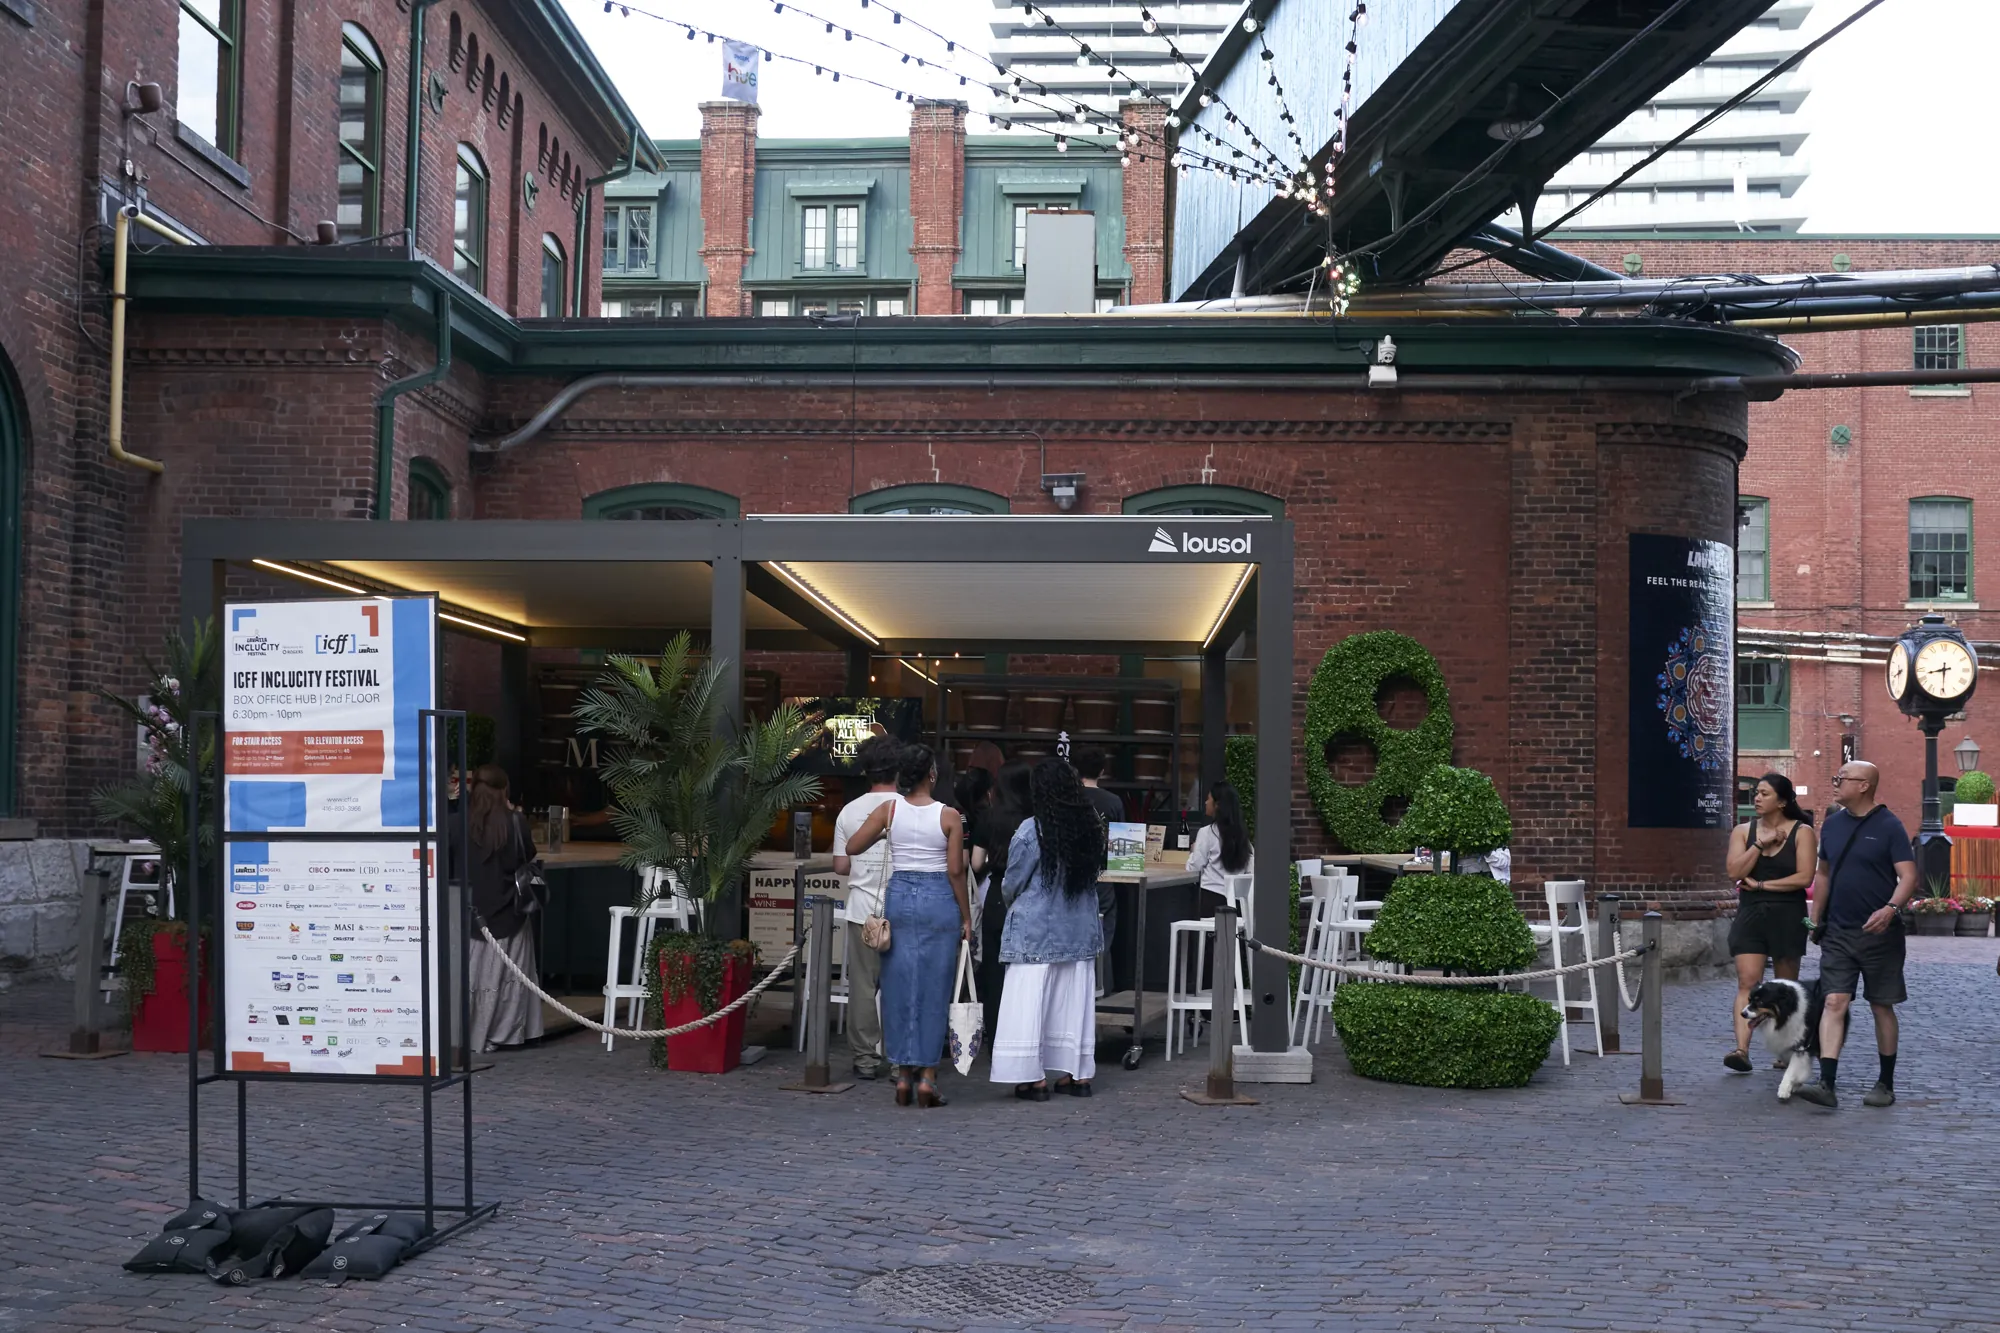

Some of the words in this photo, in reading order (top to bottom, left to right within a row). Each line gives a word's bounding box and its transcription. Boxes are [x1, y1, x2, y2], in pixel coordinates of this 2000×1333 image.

[728, 62, 756, 86] hue
[1182, 532, 1252, 554] lousol
[1647, 576, 1668, 586] FEEL
[1671, 578, 1687, 587] THE
[234, 672, 258, 688] ICFF
[261, 670, 322, 688] INCLUCITY
[325, 670, 380, 686] FESTIVAL
[233, 695, 254, 704] BOX
[257, 694, 292, 704] OFFICE
[295, 694, 317, 704] HUB
[325, 694, 342, 704] 2nd
[345, 693, 380, 704] FLOOR
[232, 710, 268, 720] 6:30pm
[277, 710, 302, 720] 10pm
[838, 719, 867, 728] WE'RE
[838, 729, 855, 739] ALL
[857, 729, 867, 739] IN
[232, 736, 243, 745] FOR
[244, 736, 260, 745] STAIR
[261, 736, 282, 745] ACCESS
[304, 736, 314, 745] FOR
[316, 736, 342, 744] ELEVATOR
[343, 736, 364, 744] ACCESS
[564, 738, 599, 768] M
